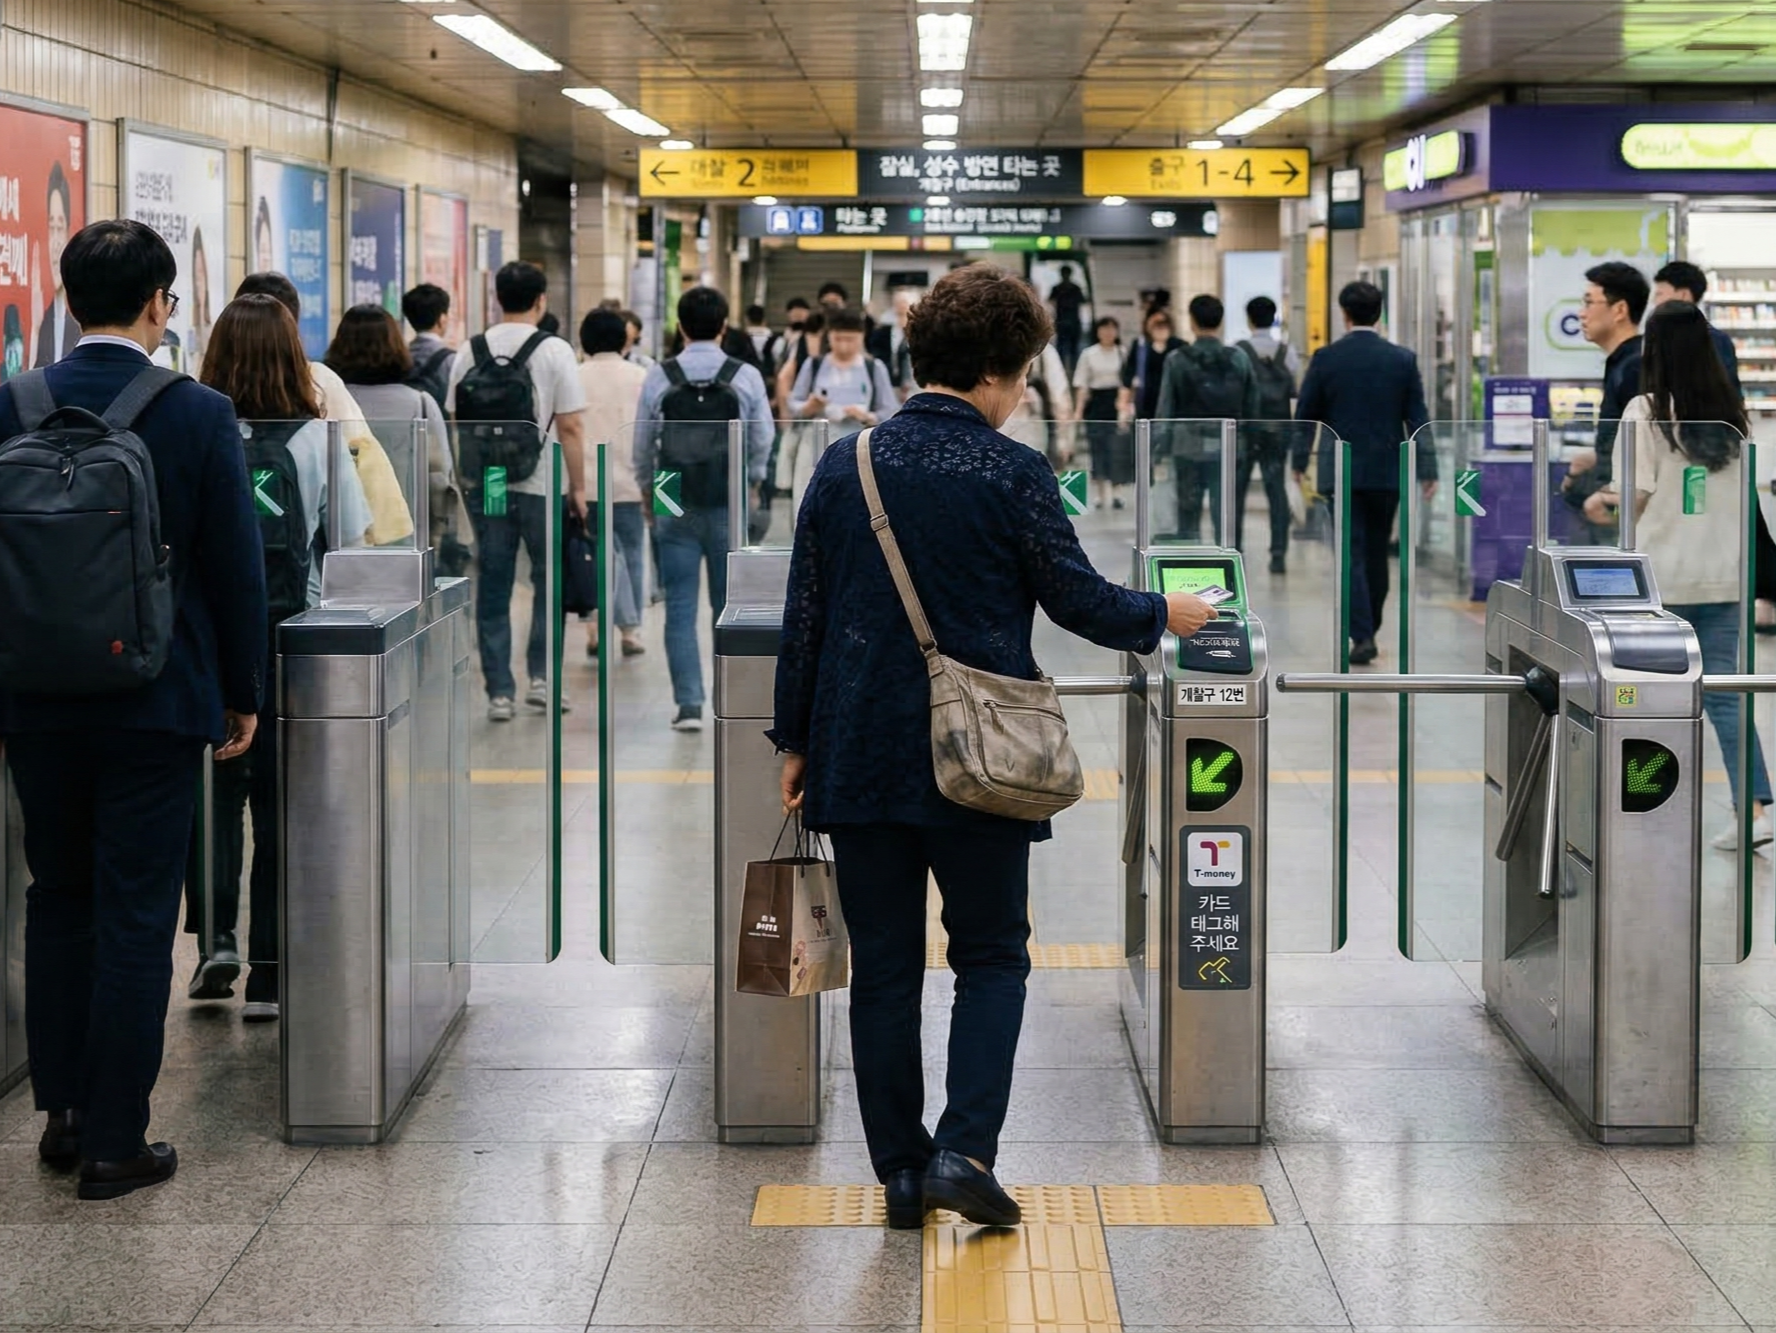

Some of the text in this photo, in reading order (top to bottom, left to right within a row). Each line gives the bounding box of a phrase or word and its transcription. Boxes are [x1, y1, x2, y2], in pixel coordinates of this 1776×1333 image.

[737, 158, 757, 188] 2
[1195, 158, 1256, 188] 1-4
[1181, 687, 1244, 703] 개찰구 12번
[1193, 869, 1236, 880] T-money
[1198, 894, 1231, 912] 카드
[1190, 914, 1239, 932] 태그해
[1189, 934, 1239, 953] 주세요
